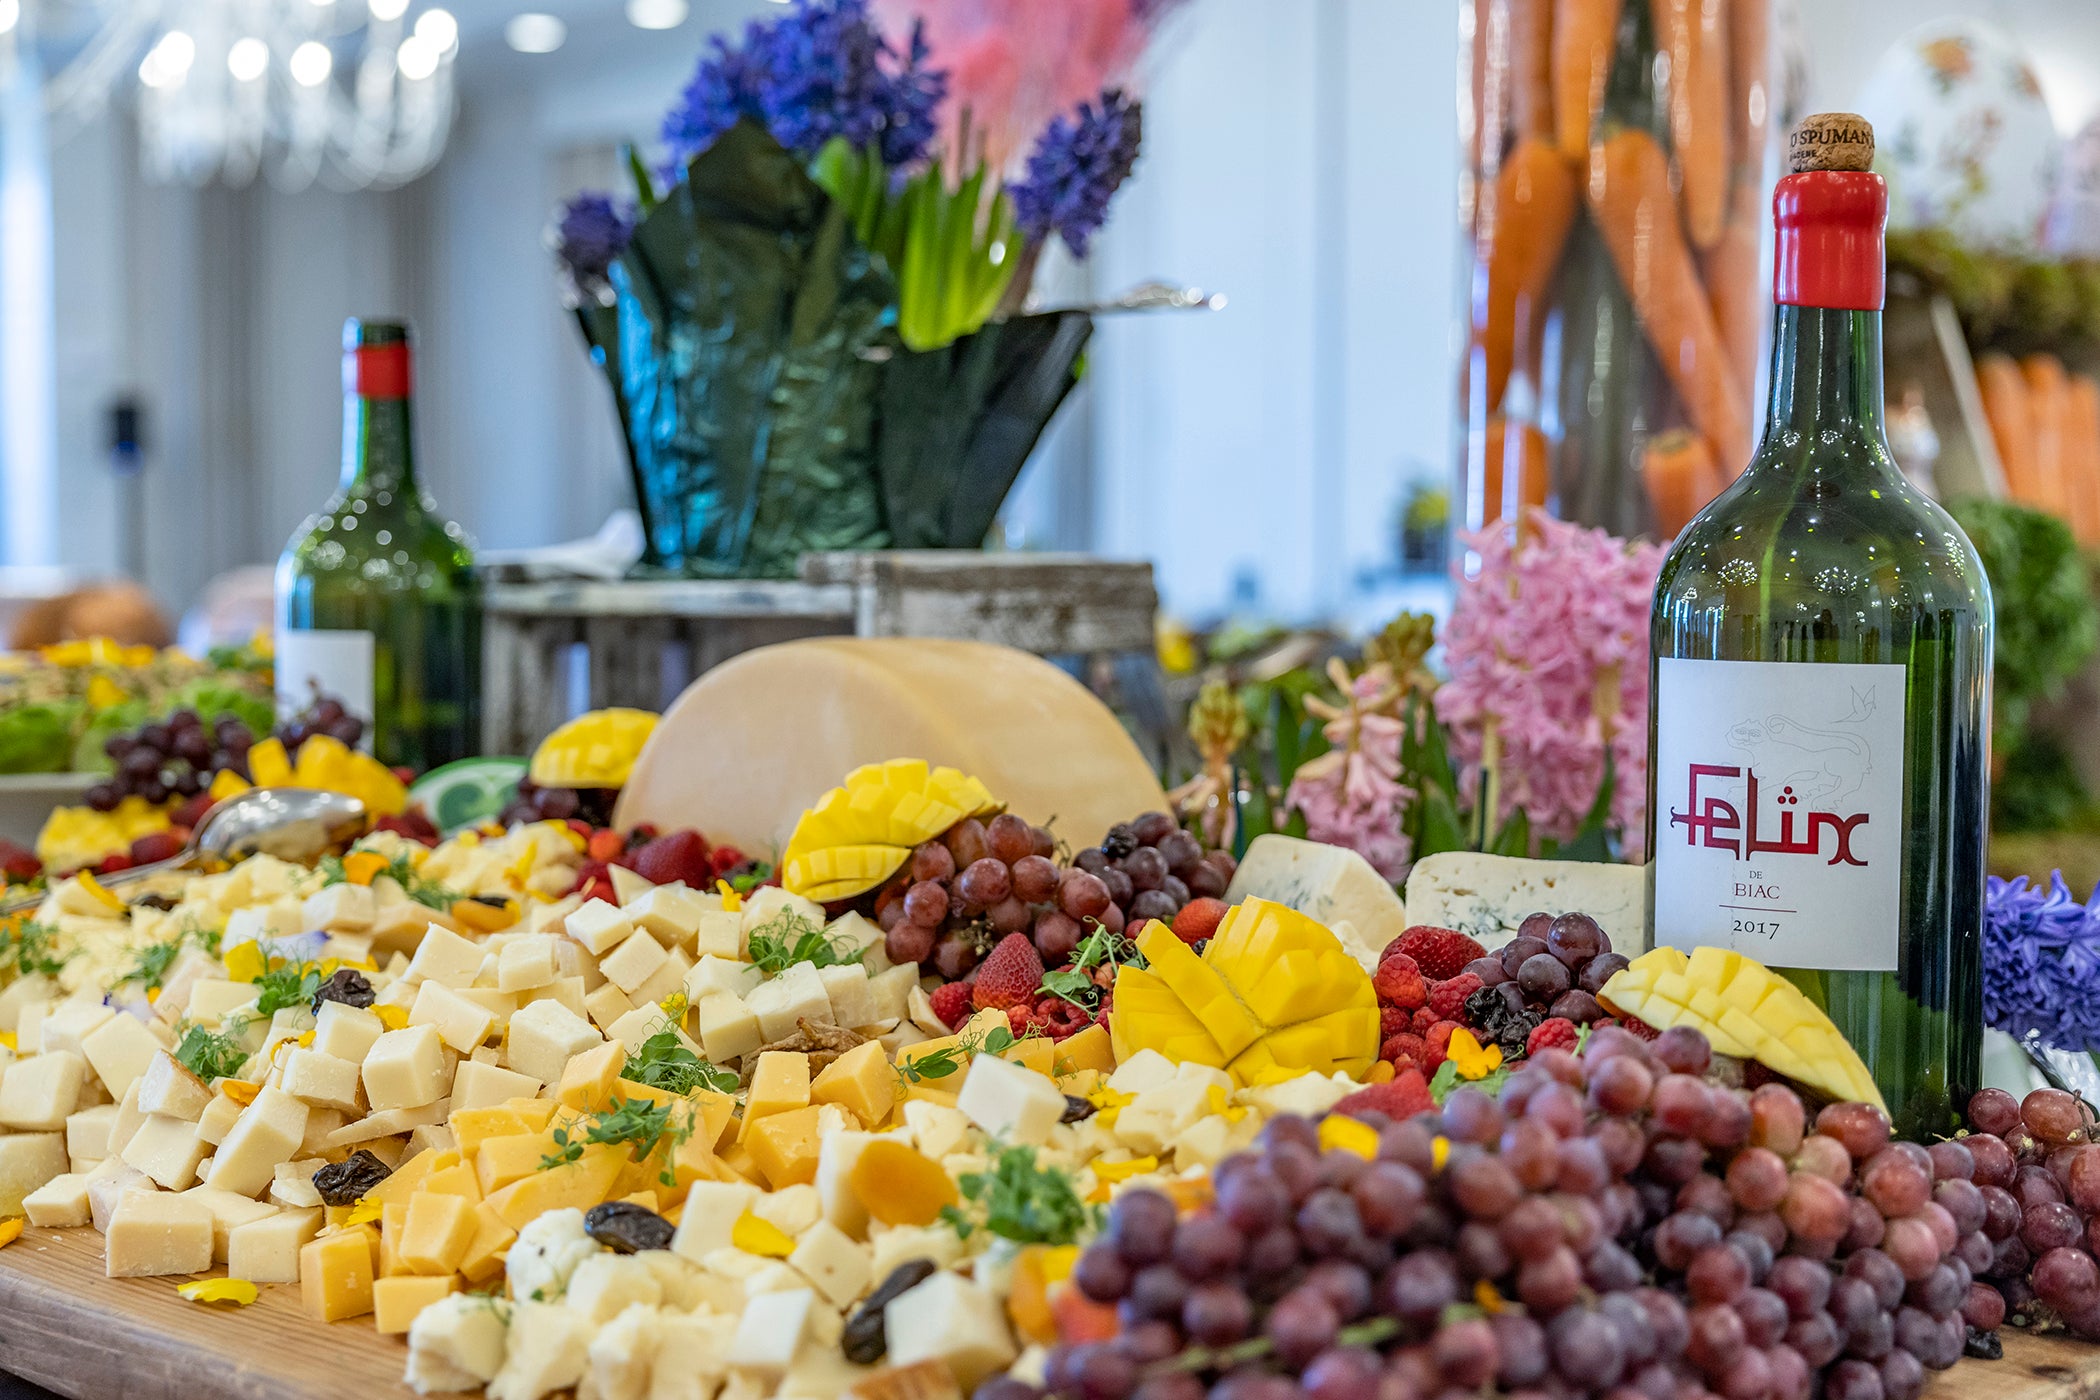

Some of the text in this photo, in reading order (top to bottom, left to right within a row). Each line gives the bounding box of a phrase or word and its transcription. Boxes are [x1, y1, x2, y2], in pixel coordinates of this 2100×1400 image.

[1749, 870, 1763, 880] DE
[1735, 882, 1780, 900] BIAC
[1733, 919, 1780, 940] 2017
